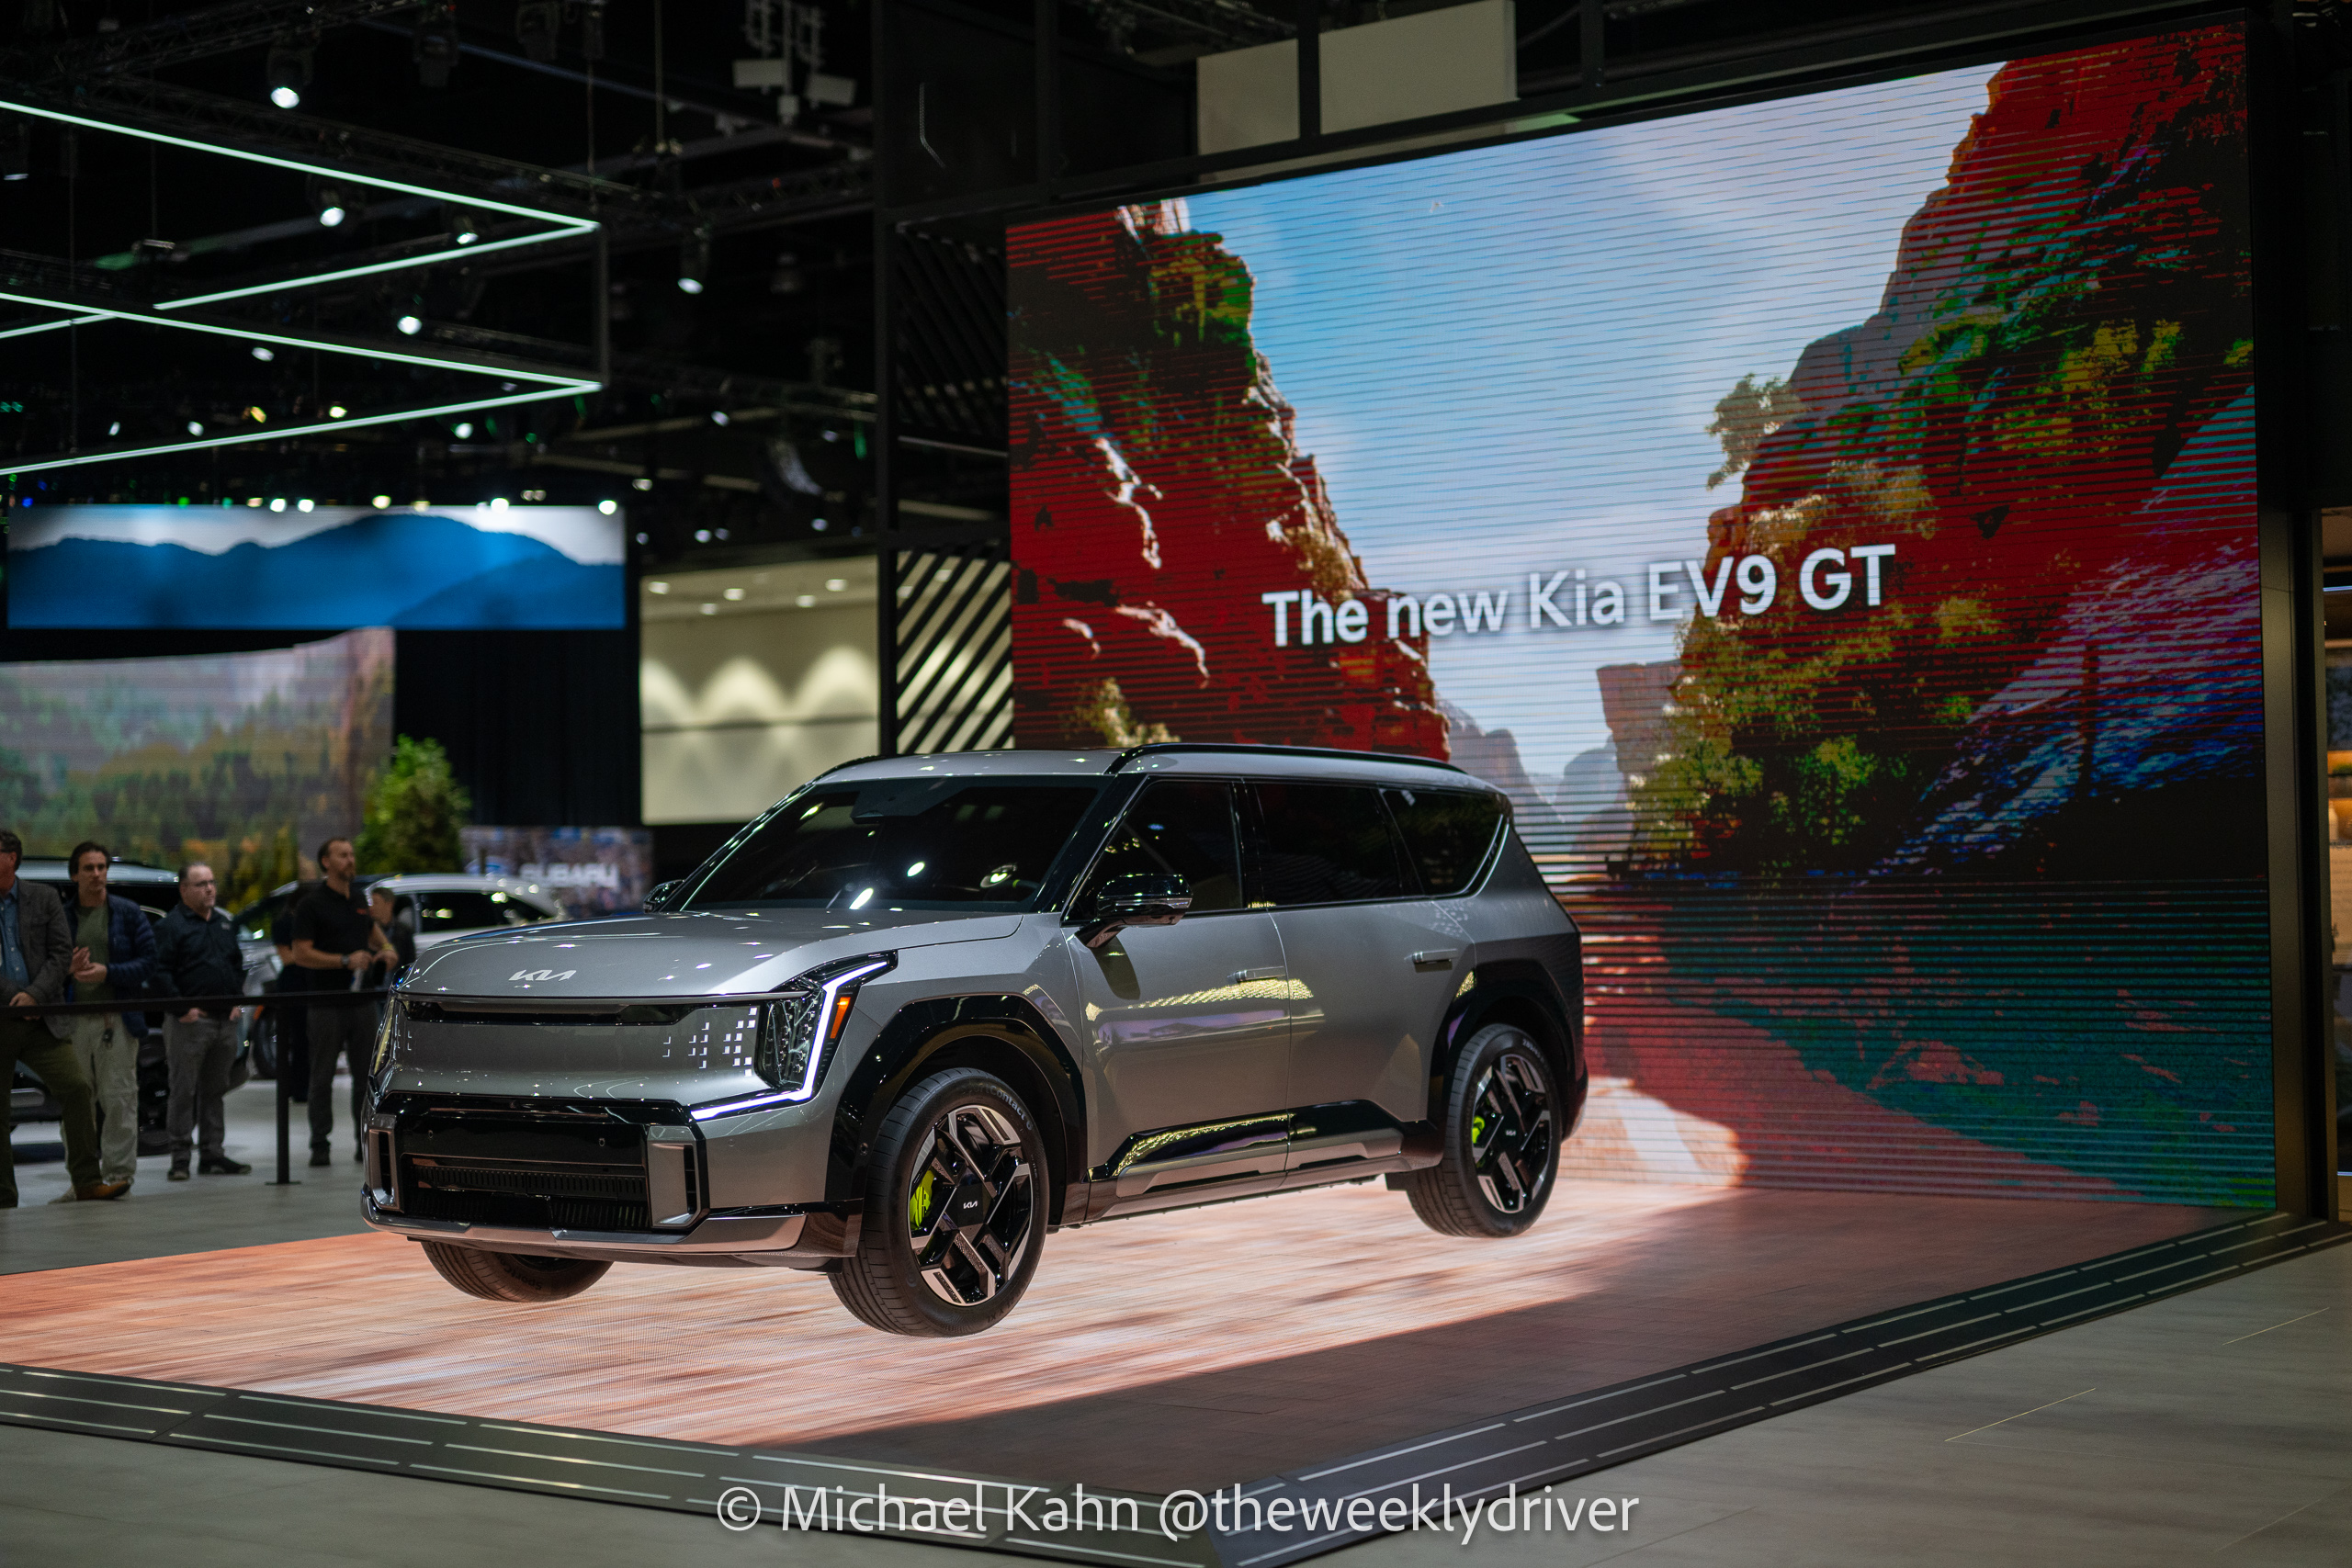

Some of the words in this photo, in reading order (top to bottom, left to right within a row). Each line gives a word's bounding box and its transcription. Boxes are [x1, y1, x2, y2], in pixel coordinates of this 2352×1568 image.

[1262, 589, 1368, 647] The
[1387, 590, 1509, 639] new
[1529, 569, 1625, 628] Kia
[1649, 554, 1777, 621] EV9
[1799, 544, 1896, 613] GT
[519, 863, 620, 889] SUBARU
